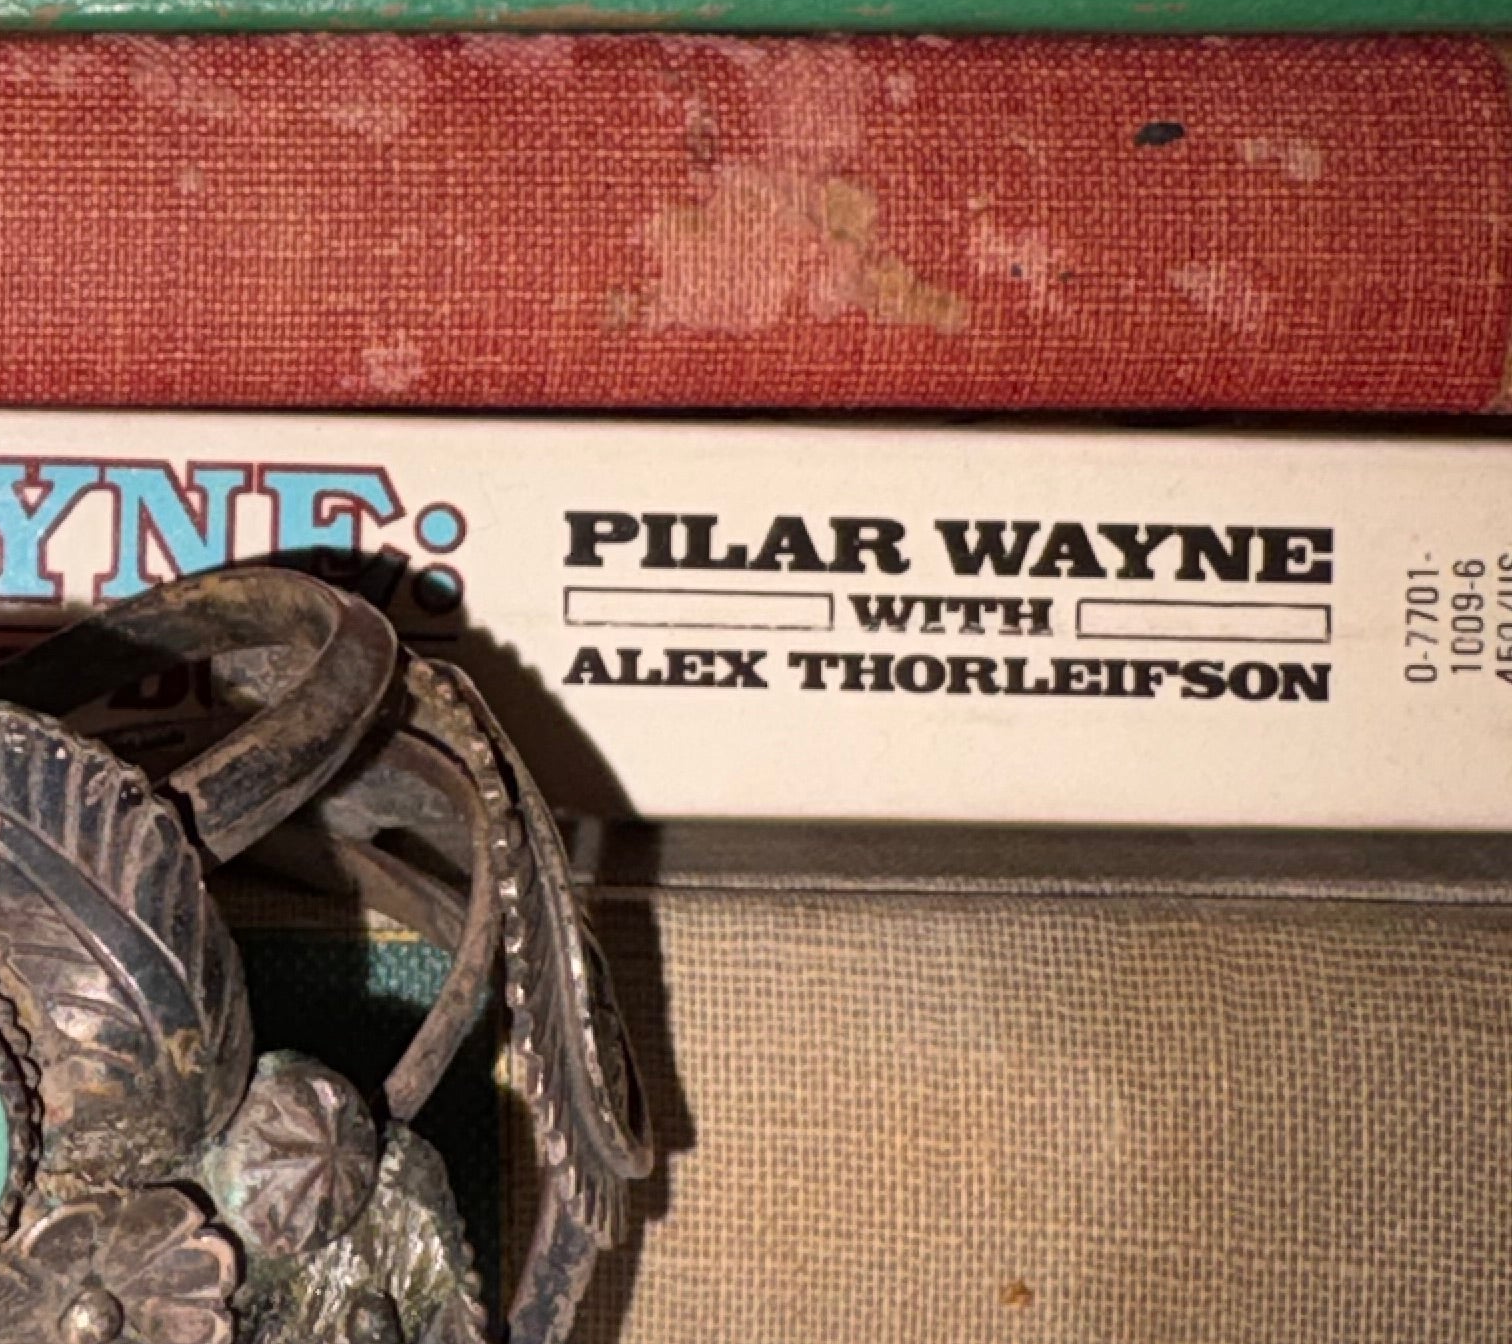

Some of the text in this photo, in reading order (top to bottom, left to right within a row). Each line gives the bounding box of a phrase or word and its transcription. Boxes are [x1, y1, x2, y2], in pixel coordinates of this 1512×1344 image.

[562, 509, 1335, 585] PILAR WAYNE
[847, 593, 1055, 637] WITH
[1403, 550, 1440, 684] 0-7701-
[1450, 558, 1486, 674] 1009-6
[562, 646, 1332, 704] ALEX THORLEIFSON
